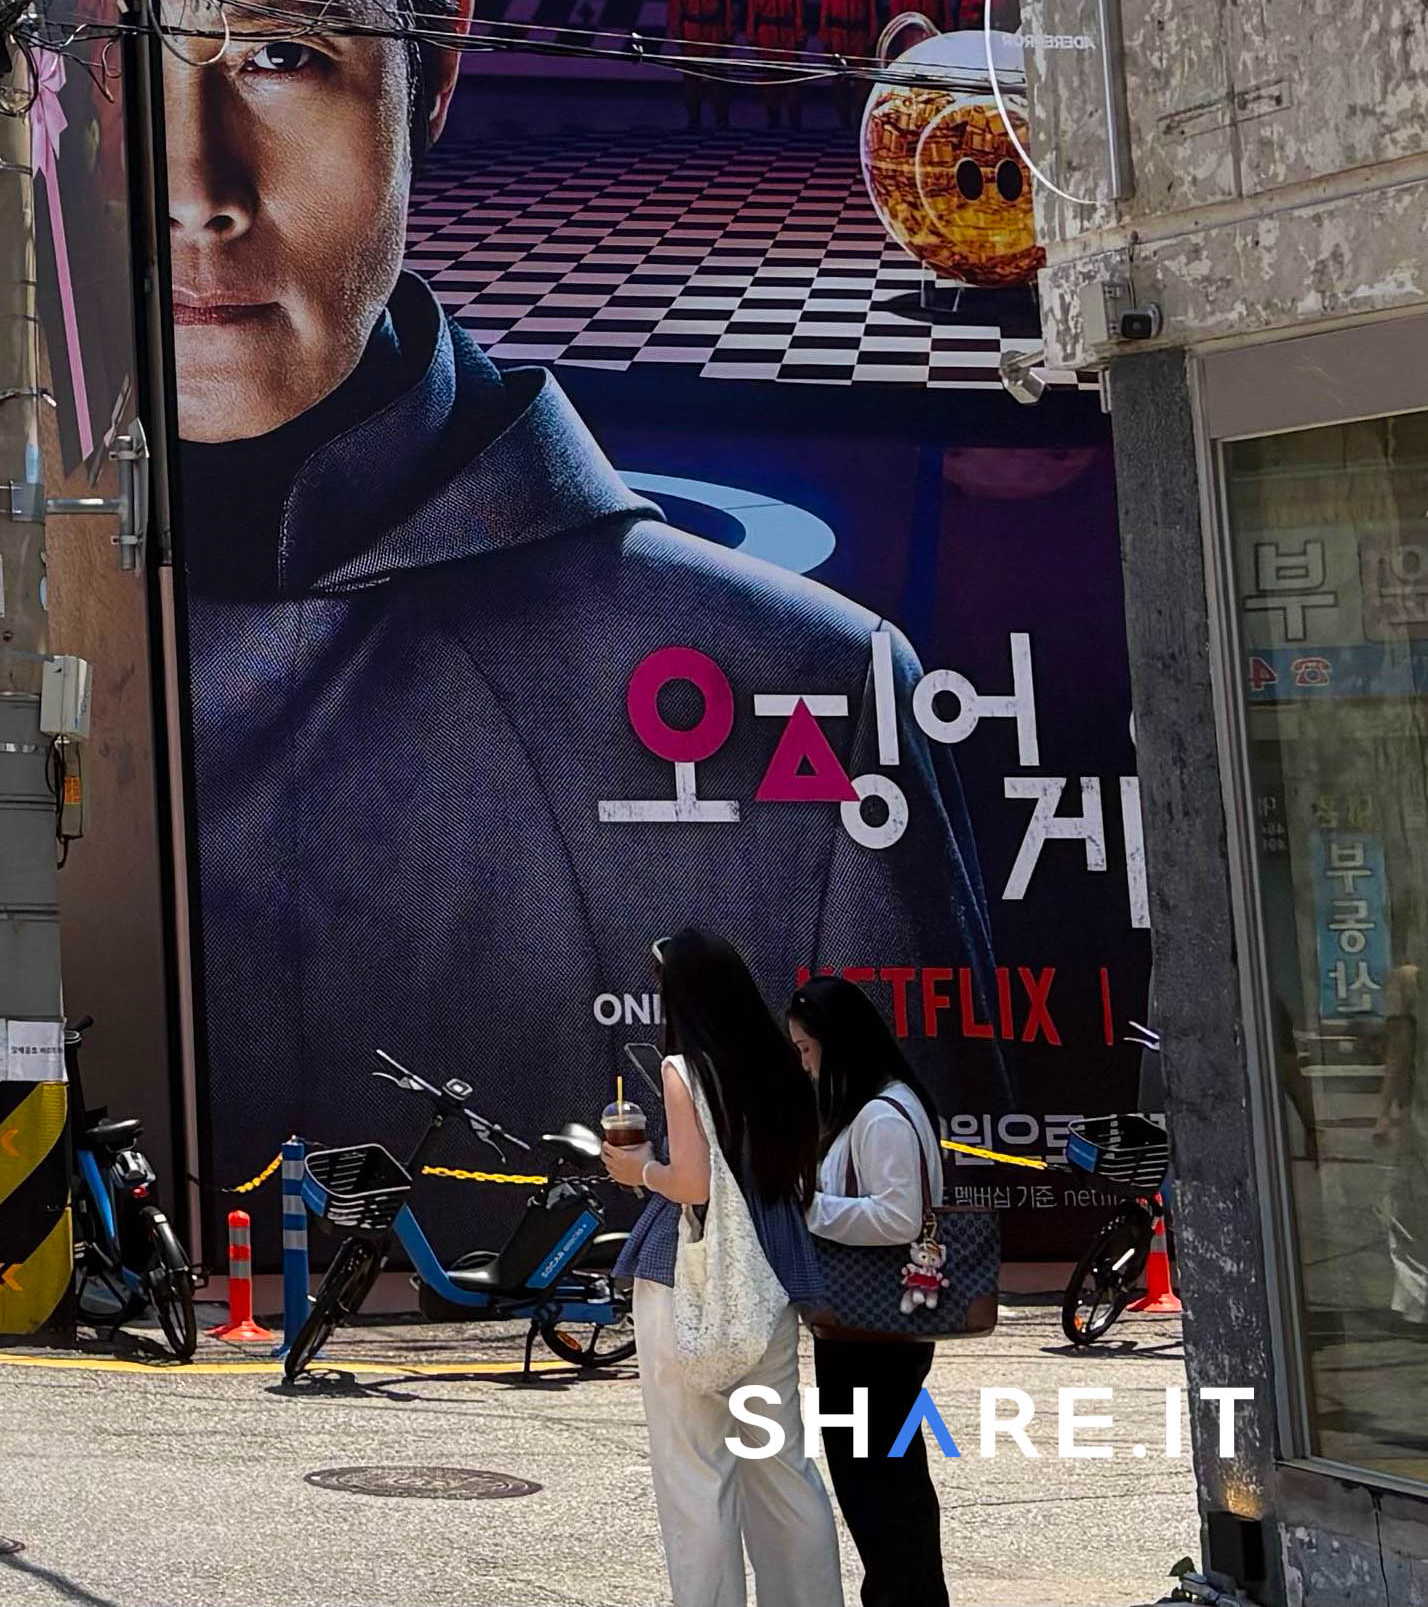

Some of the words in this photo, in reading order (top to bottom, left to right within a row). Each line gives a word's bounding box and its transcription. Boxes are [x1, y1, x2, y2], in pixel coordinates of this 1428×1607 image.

[598, 631, 1040, 850] 오징어
[1001, 711, 1151, 929] 게
[593, 992, 667, 1026] ONL
[796, 966, 1063, 1047] TFLIX
[939, 1113, 1086, 1167] 원으로
[954, 1185, 1012, 1209] 멤버십
[1017, 1185, 1058, 1209] 기준
